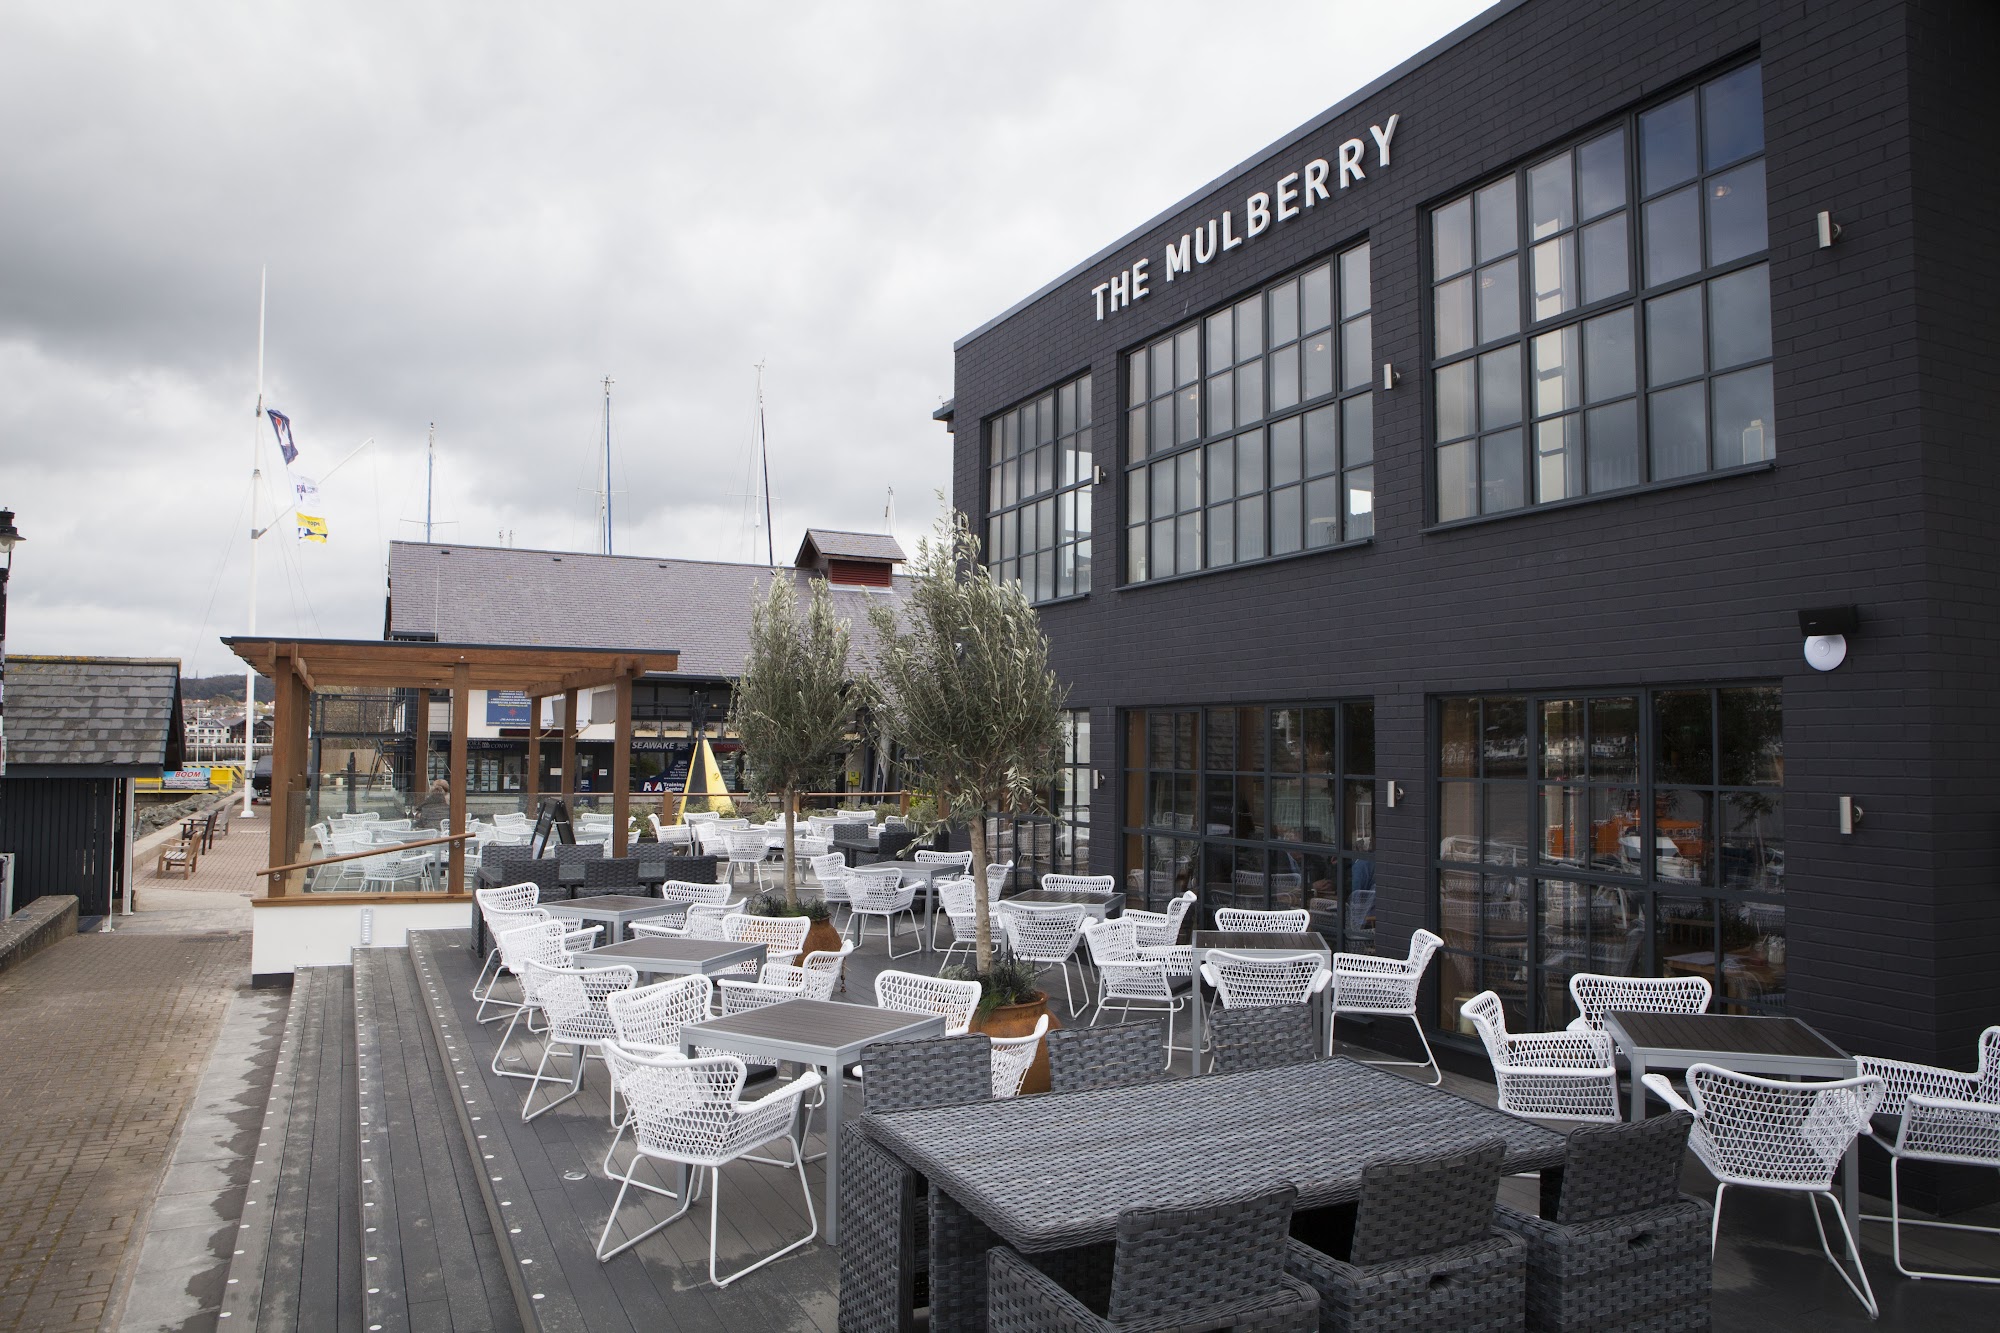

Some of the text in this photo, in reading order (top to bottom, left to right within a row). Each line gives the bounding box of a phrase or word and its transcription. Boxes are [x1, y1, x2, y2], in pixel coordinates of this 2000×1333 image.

[1091, 113, 1399, 321] THE MULBERRY
[632, 742, 675, 750] SEAWAKE
[643, 782, 663, 791] RYA
